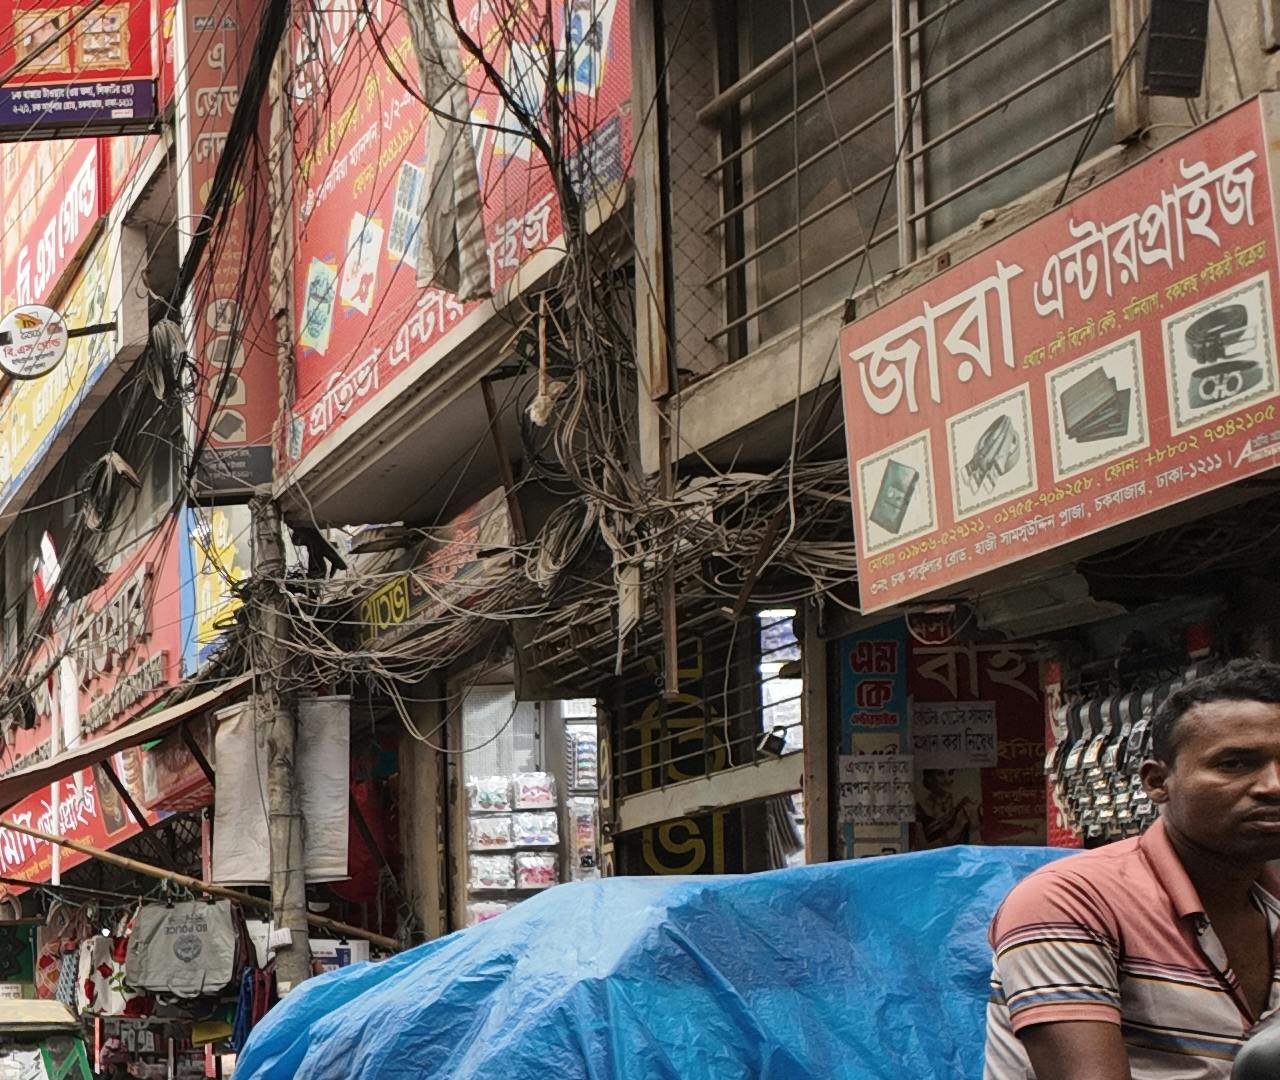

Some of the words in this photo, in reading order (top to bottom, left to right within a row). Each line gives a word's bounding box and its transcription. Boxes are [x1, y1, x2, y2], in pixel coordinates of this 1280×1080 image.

[848, 259, 1024, 415] জারা
[1032, 150, 1257, 320] এন্টারপ্রাইজ
[1144, 437, 1200, 467] +৮৮০২
[1203, 404, 1276, 443] ৭৩৪২১০৫
[164, 924, 194, 936] POLICE
